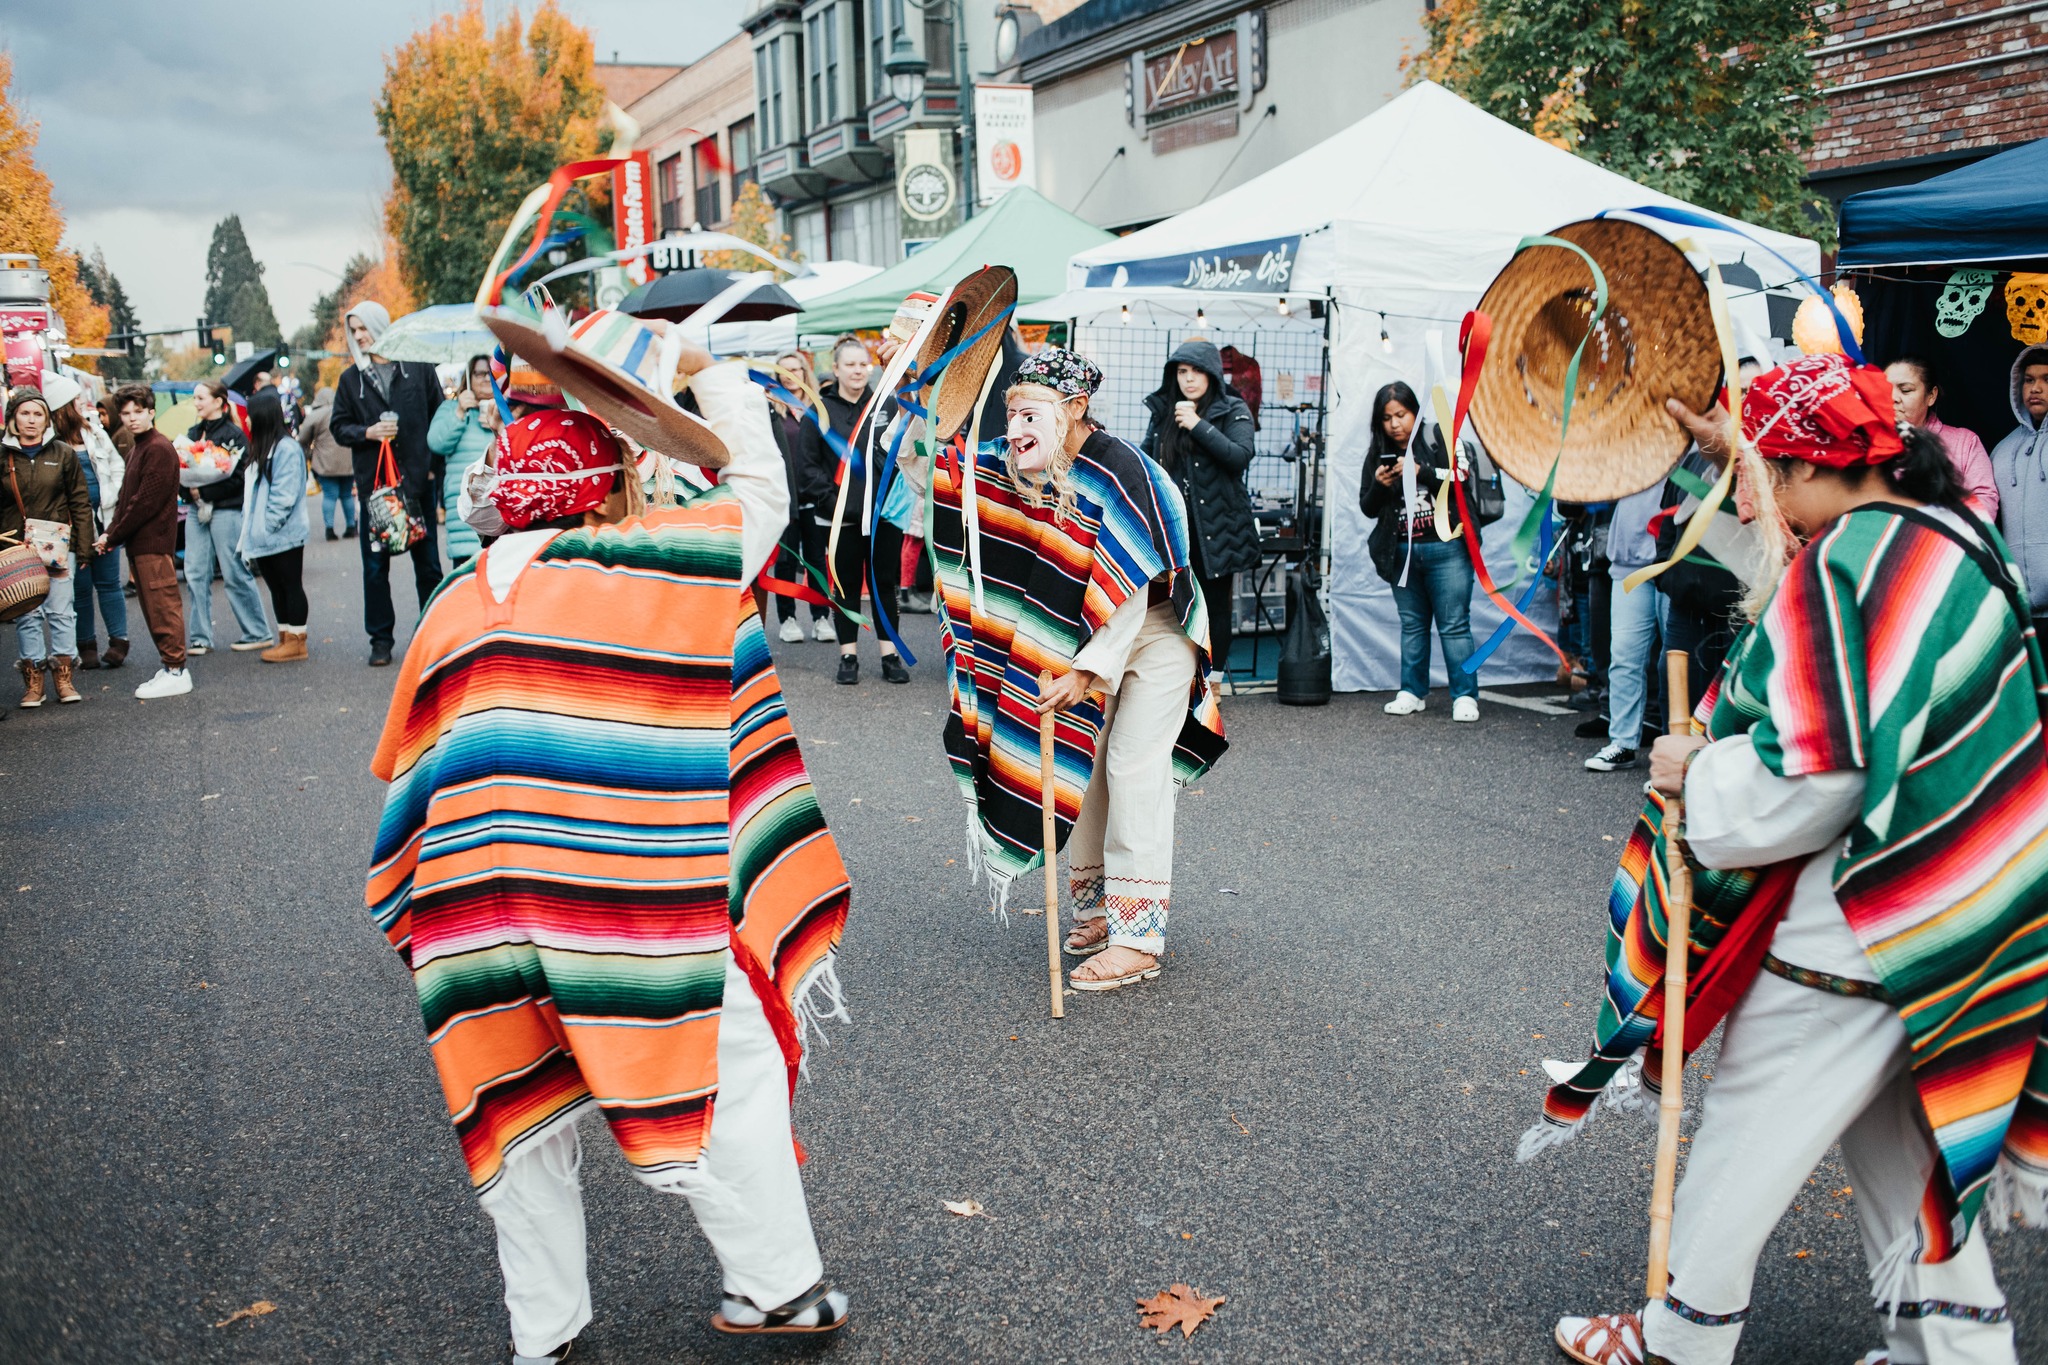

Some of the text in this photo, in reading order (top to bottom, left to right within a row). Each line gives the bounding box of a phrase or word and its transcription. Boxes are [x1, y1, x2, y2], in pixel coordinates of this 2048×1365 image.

[1147, 44, 1234, 107] Valley Art
[1183, 243, 1291, 289] Midnite Oils
